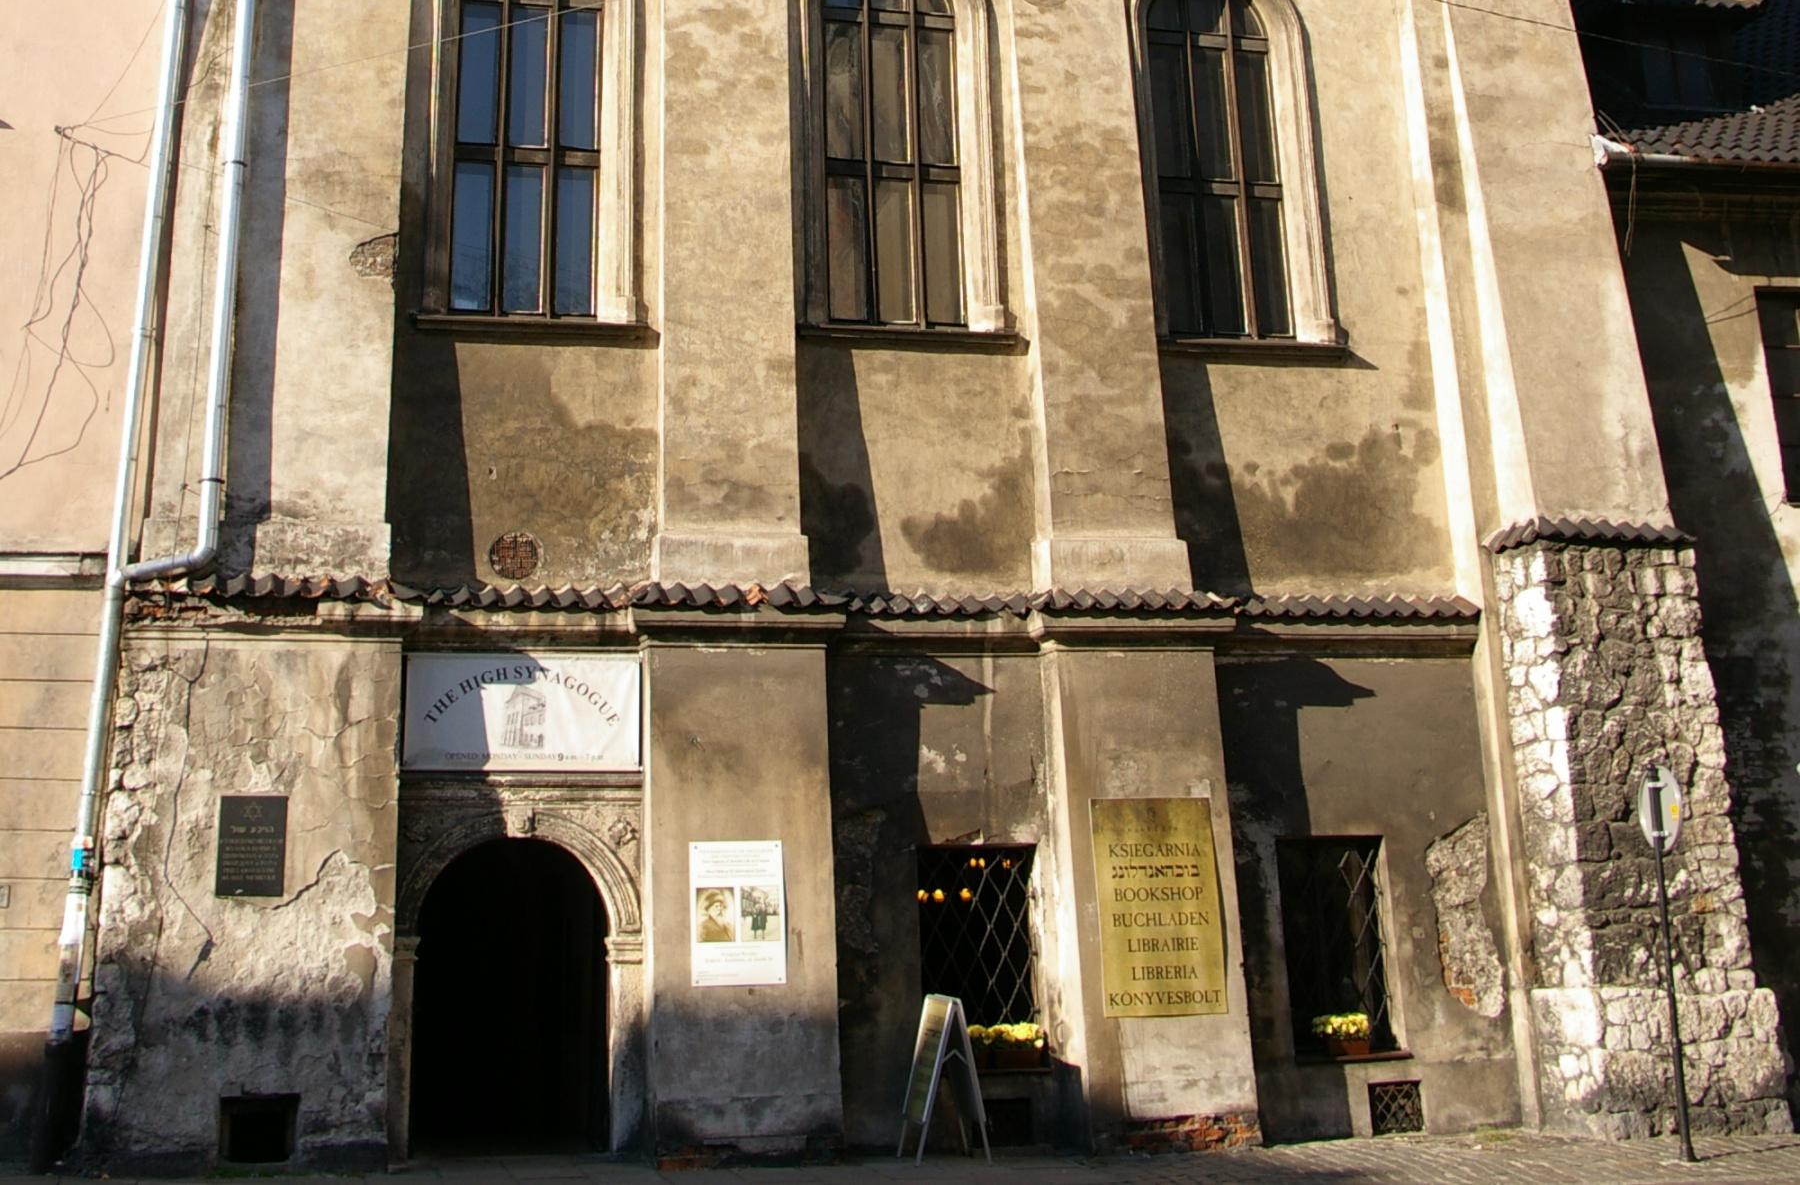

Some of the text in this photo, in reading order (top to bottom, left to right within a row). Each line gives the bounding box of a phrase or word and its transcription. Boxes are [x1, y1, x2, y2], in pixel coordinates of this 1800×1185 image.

[424, 665, 621, 727] THE HIGH SYNAGOGUE
[557, 752, 564, 762] 9
[1114, 886, 1203, 902] BOOKSHOP
[1112, 911, 1209, 928] BUCHLADEN
[1127, 936, 1199, 953] LIBRAIRIE
[1131, 965, 1199, 981] LIBRERIA
